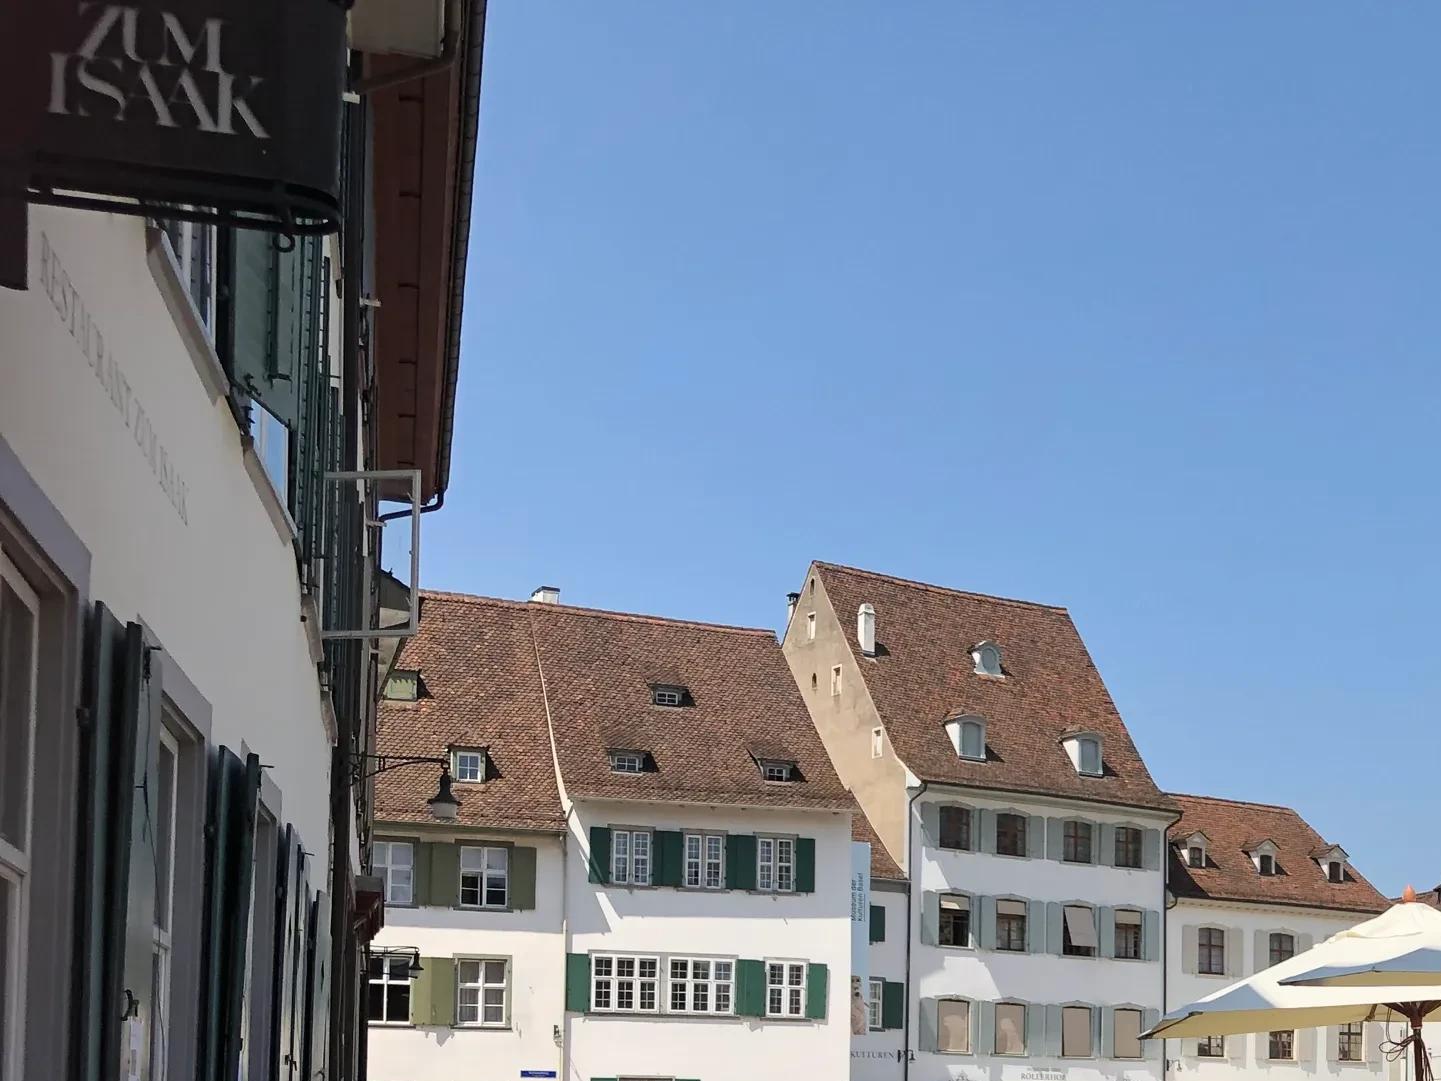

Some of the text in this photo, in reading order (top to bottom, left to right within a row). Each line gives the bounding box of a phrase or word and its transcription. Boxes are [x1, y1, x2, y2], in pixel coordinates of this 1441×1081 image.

[77, 1, 226, 72] ZUM
[46, 52, 272, 138] ISAAK
[41, 230, 131, 428] RESTAURANT
[133, 397, 157, 476] ZUM
